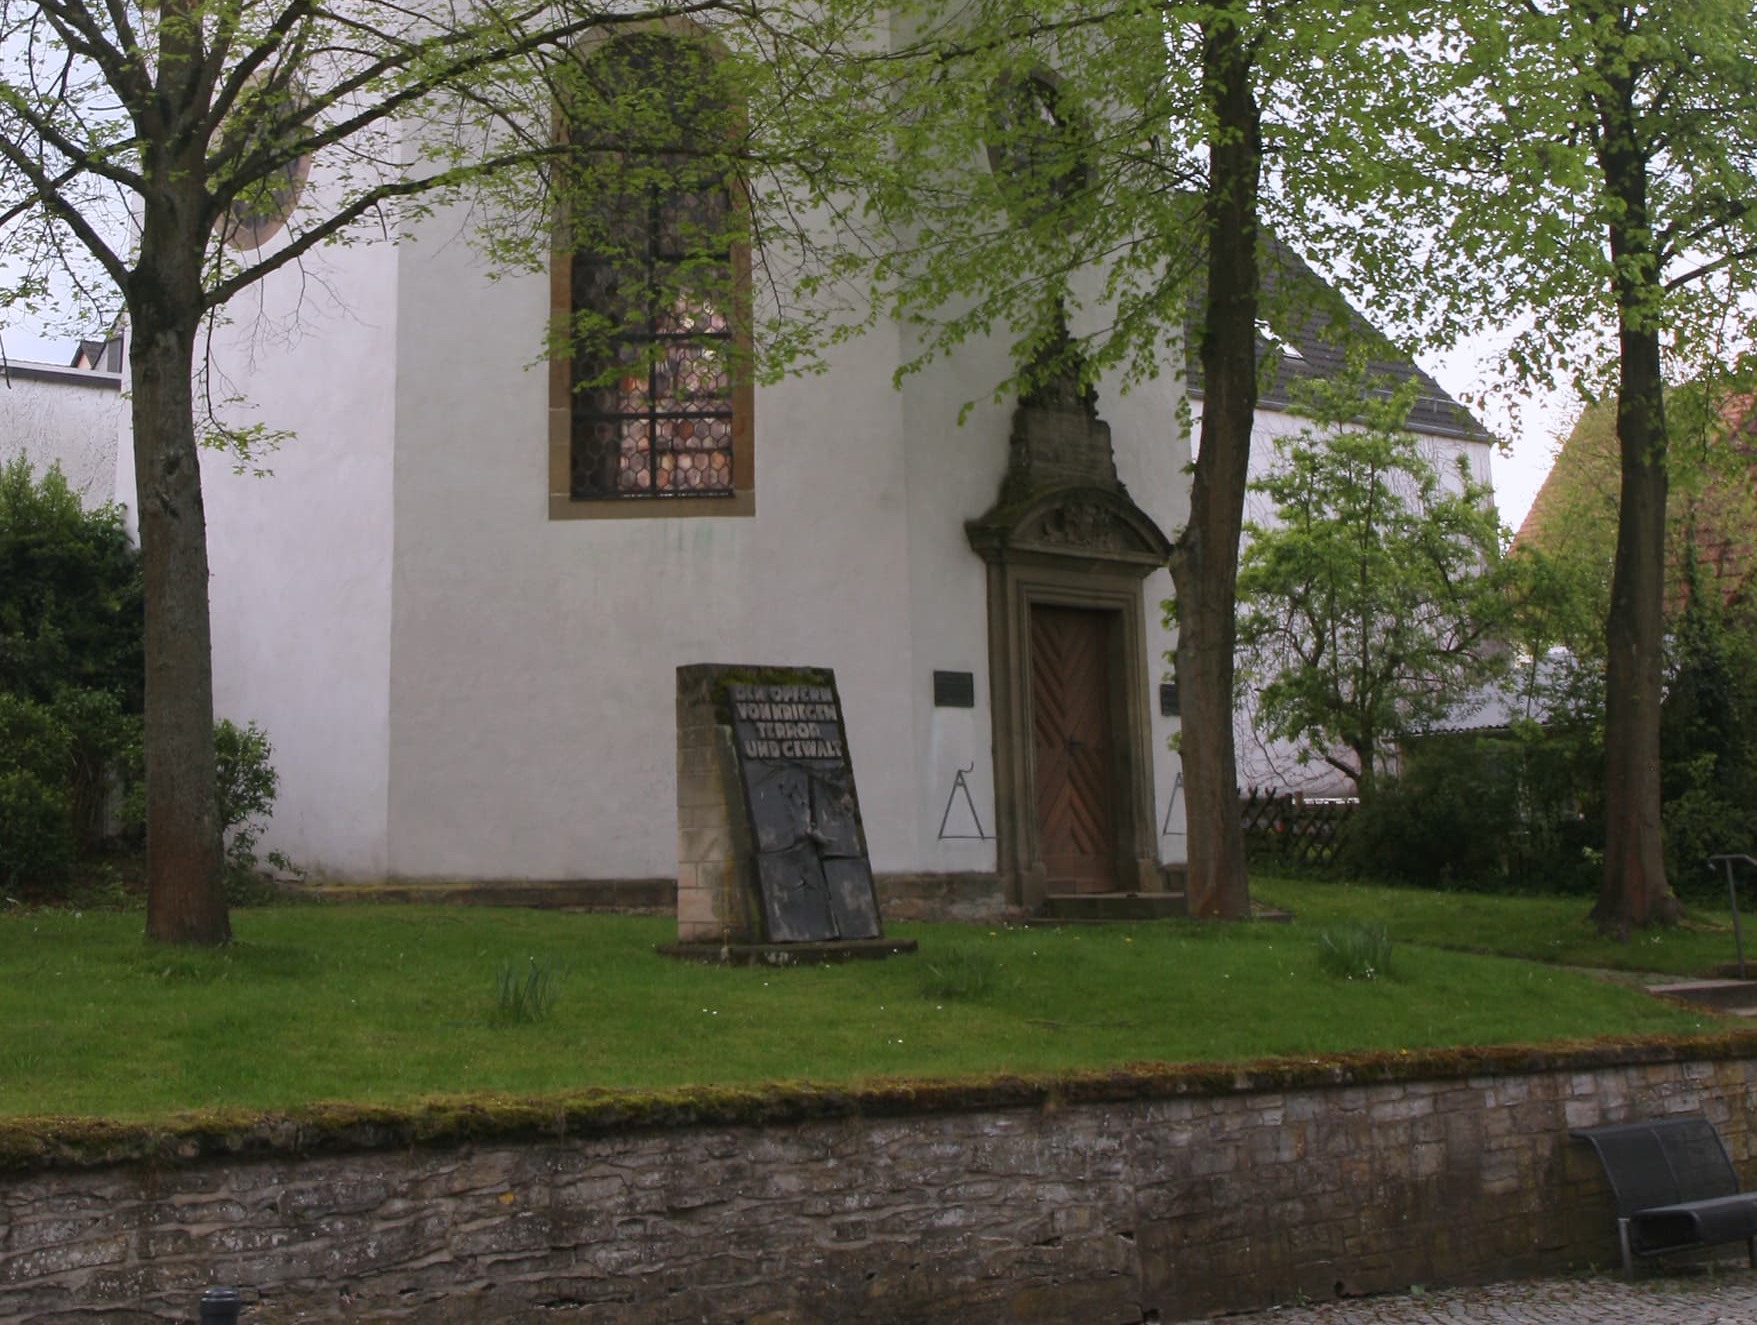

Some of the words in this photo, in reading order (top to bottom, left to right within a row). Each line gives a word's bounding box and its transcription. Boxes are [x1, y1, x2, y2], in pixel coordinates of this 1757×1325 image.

[736, 703, 771, 720] VON
[772, 703, 838, 721] KRIEGEN
[756, 722, 821, 738] TERROR
[744, 740, 780, 757] UND
[781, 740, 842, 757] GEWALT
